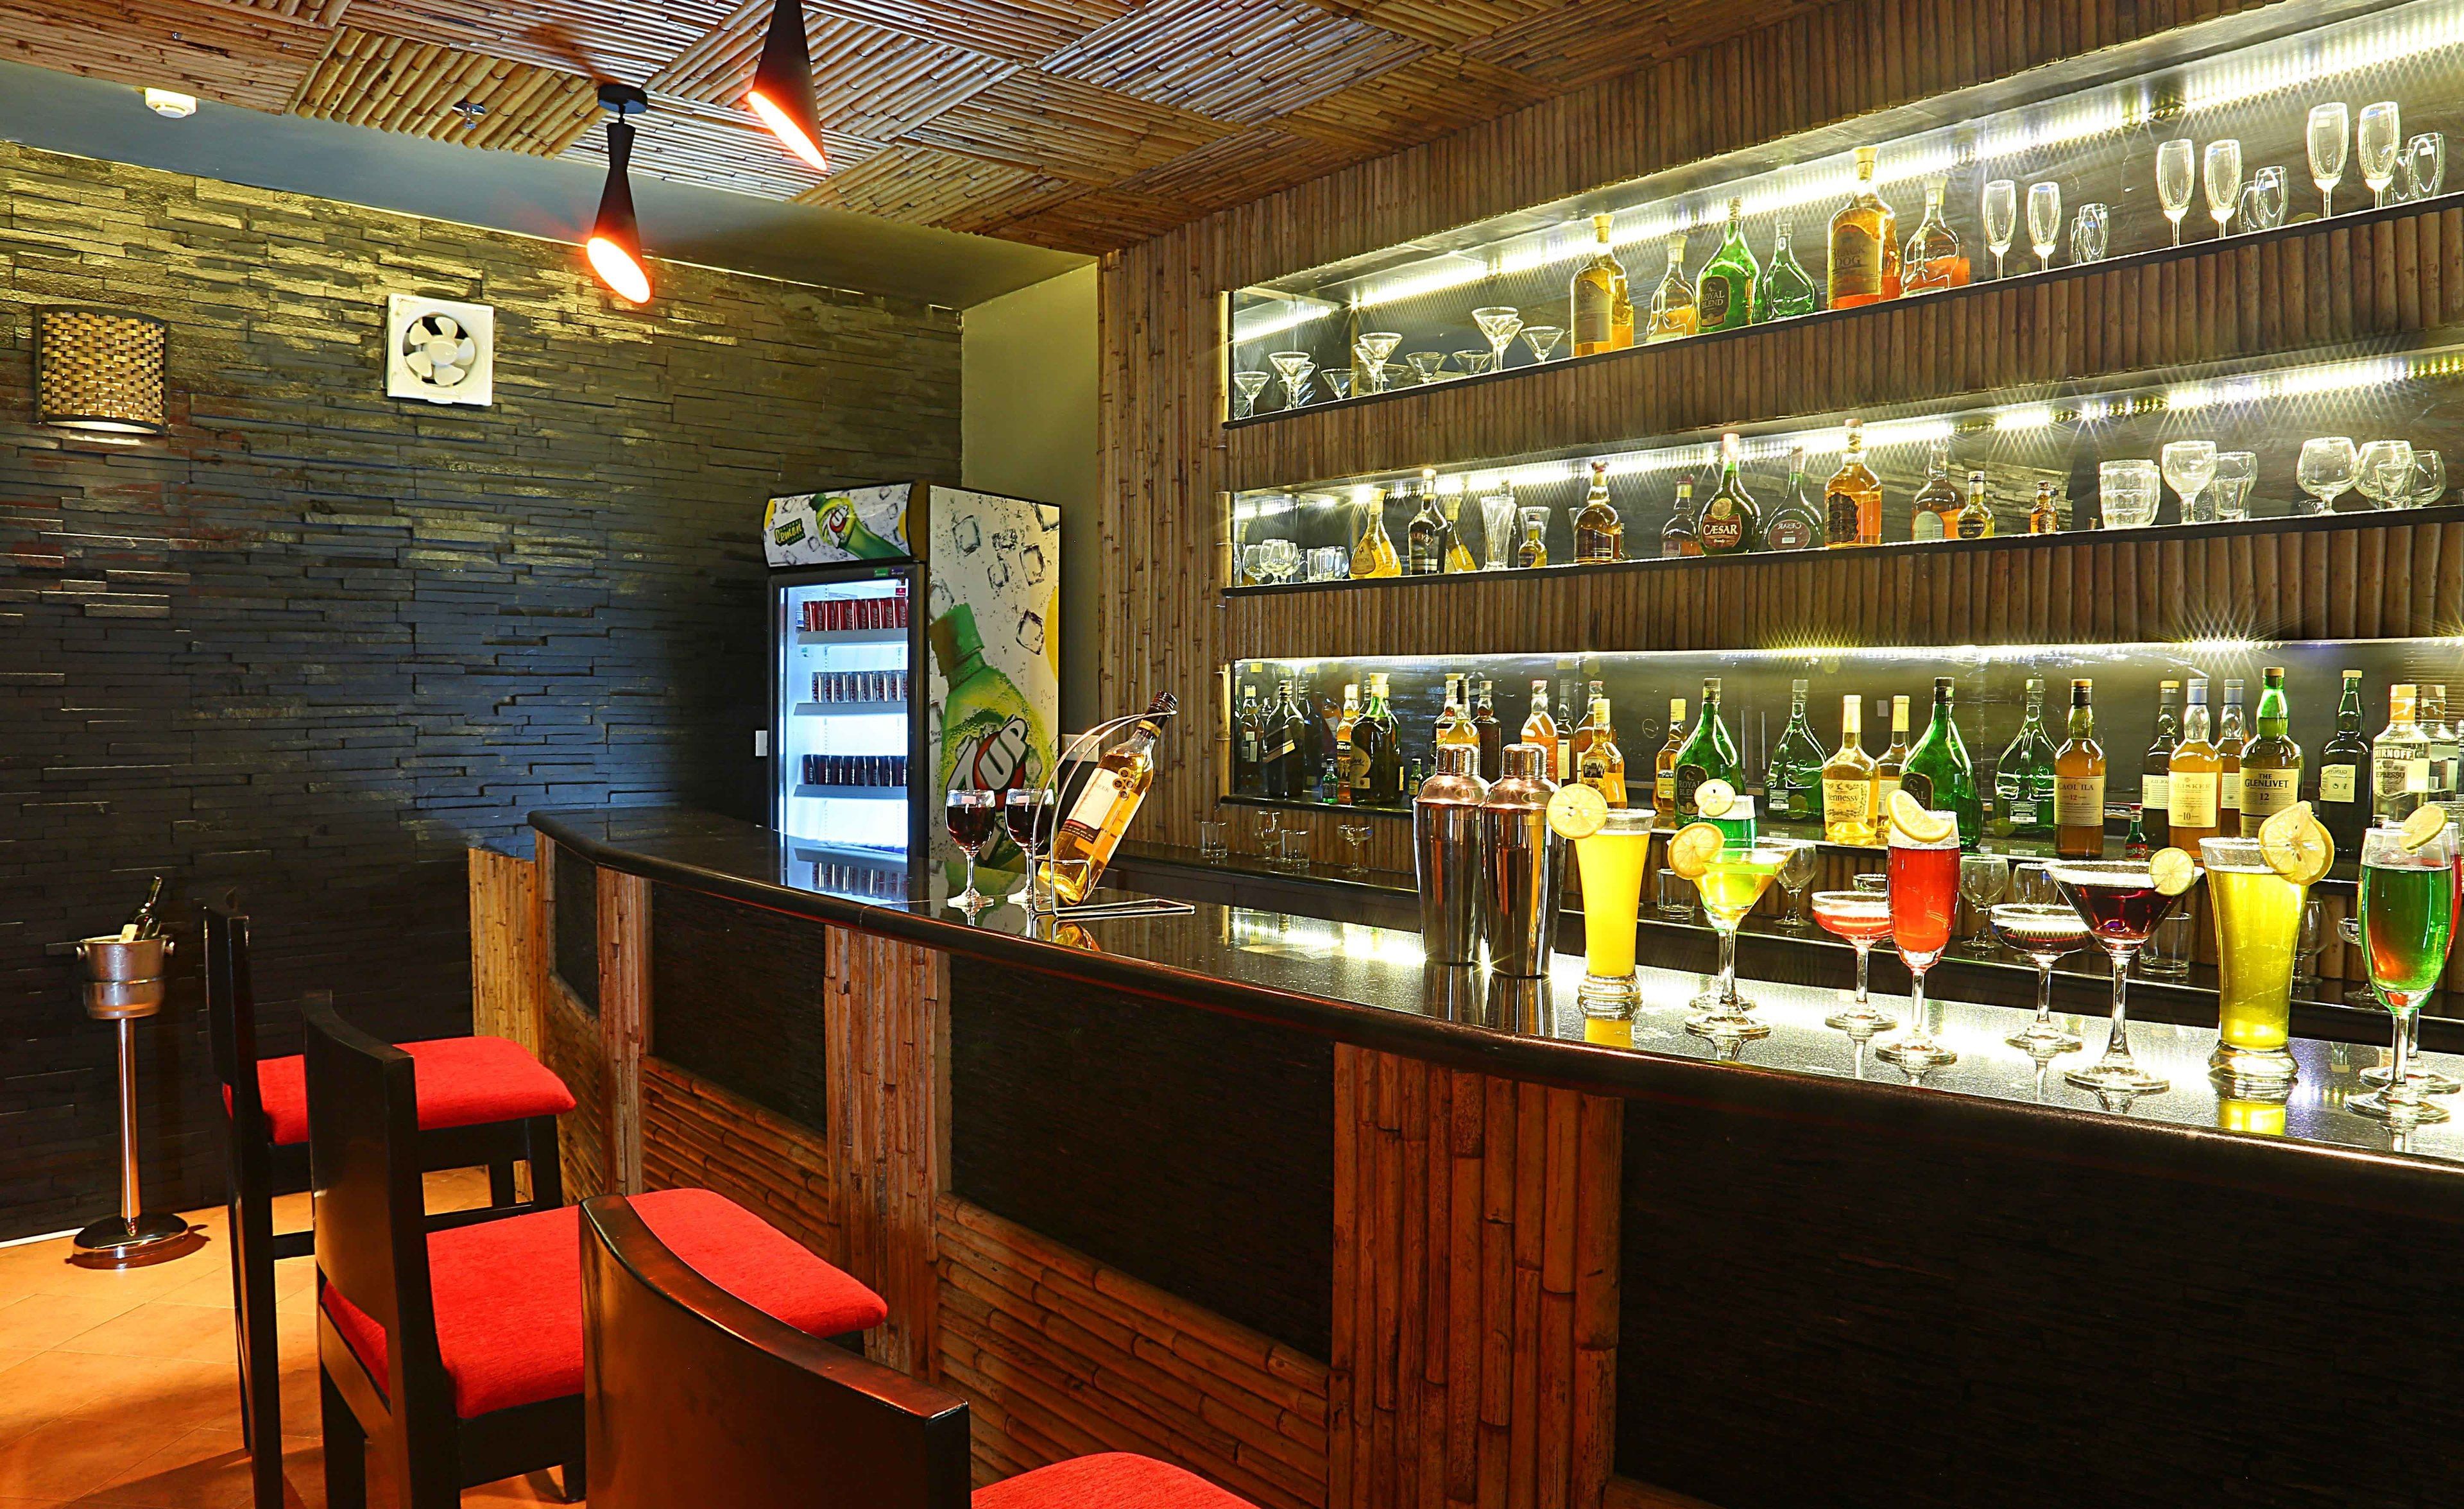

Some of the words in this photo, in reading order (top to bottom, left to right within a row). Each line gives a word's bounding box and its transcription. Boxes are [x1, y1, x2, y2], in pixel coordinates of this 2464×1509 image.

[2245, 778, 2289, 789] GLENLIVET
[1826, 792, 1859, 802] Hennessy
[2183, 812, 2191, 821] 10
